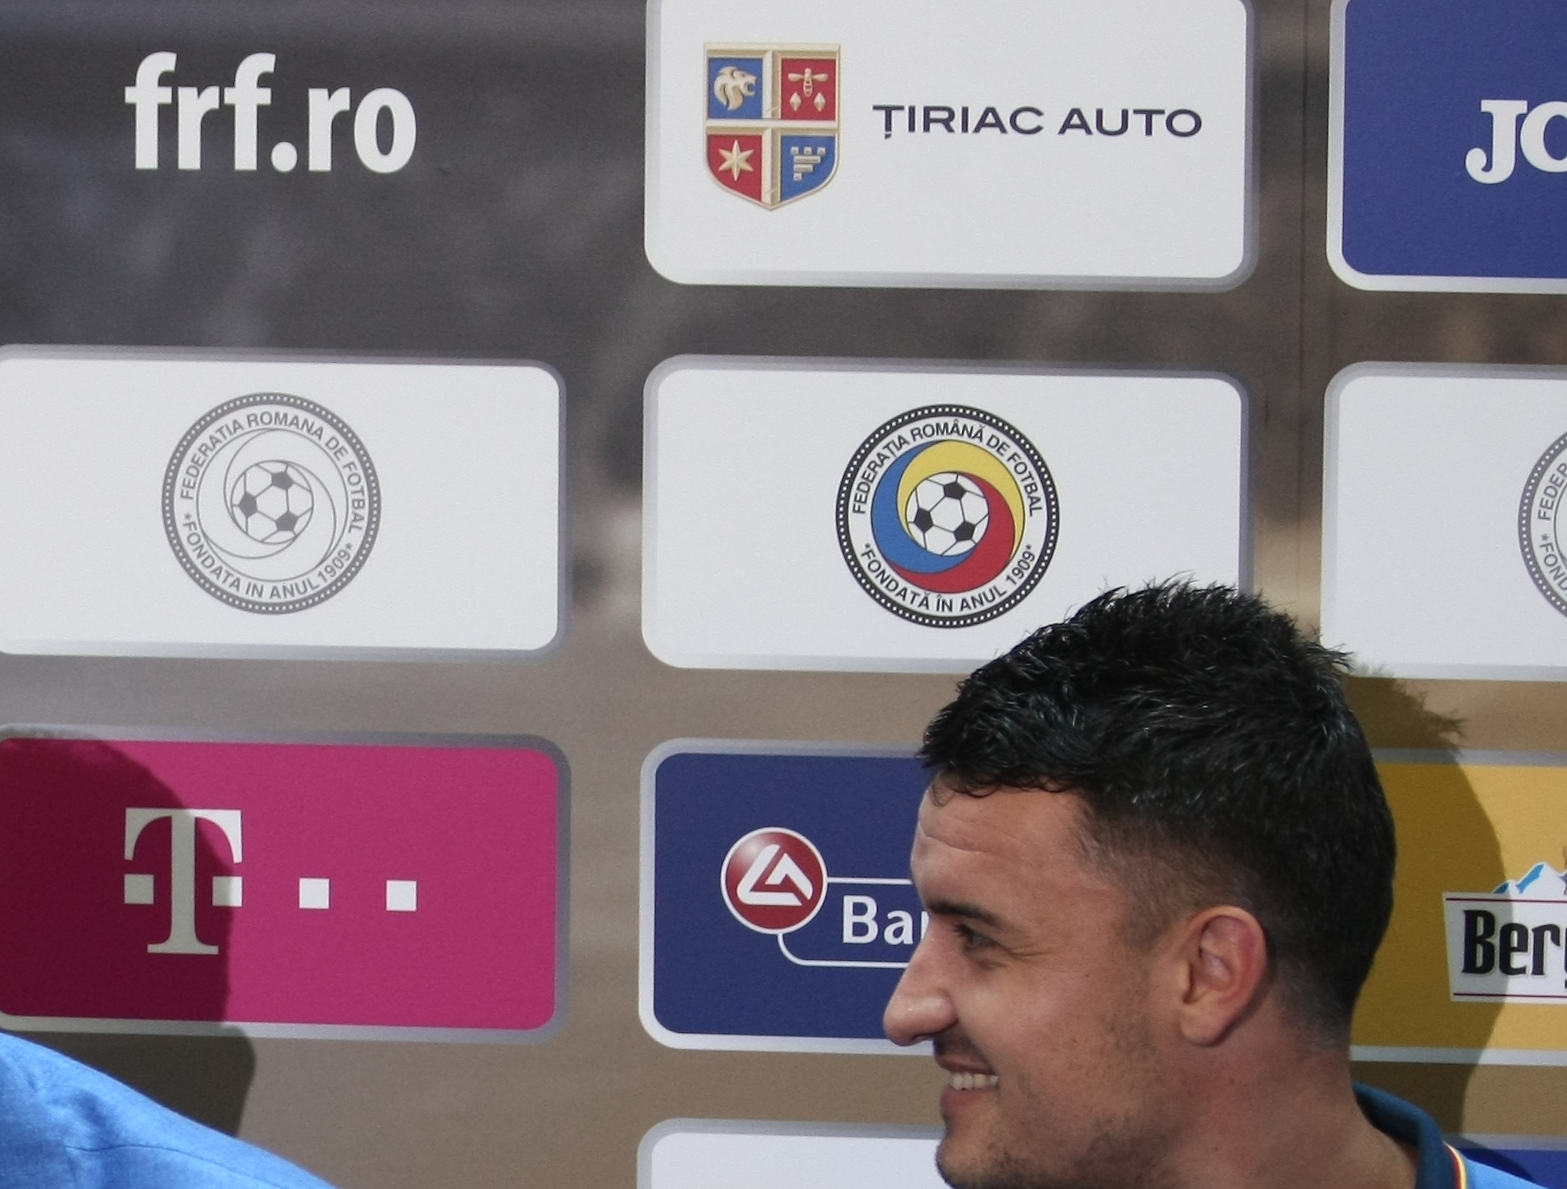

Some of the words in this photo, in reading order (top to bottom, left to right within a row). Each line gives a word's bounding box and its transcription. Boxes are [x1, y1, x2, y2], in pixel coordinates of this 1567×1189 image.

[125, 52, 417, 173] frf.ro
[1057, 108, 1203, 138] AUTO
[180, 419, 244, 500] FEDERATIA
[246, 412, 325, 440] ROMANA
[325, 436, 349, 462] DE
[342, 462, 365, 534] FOTBAL
[986, 434, 1010, 457] DE
[1007, 453, 1042, 517] FOTBAL
[182, 520, 241, 592] FONDATA
[245, 582, 264, 598] IN
[269, 578, 320, 599] ANUL
[318, 549, 351, 583] 1909
[936, 595, 953, 612] ÎN
[960, 585, 1007, 612] ANUL
[1006, 551, 1036, 585] 1909
[1462, 909, 1567, 989] Ber
